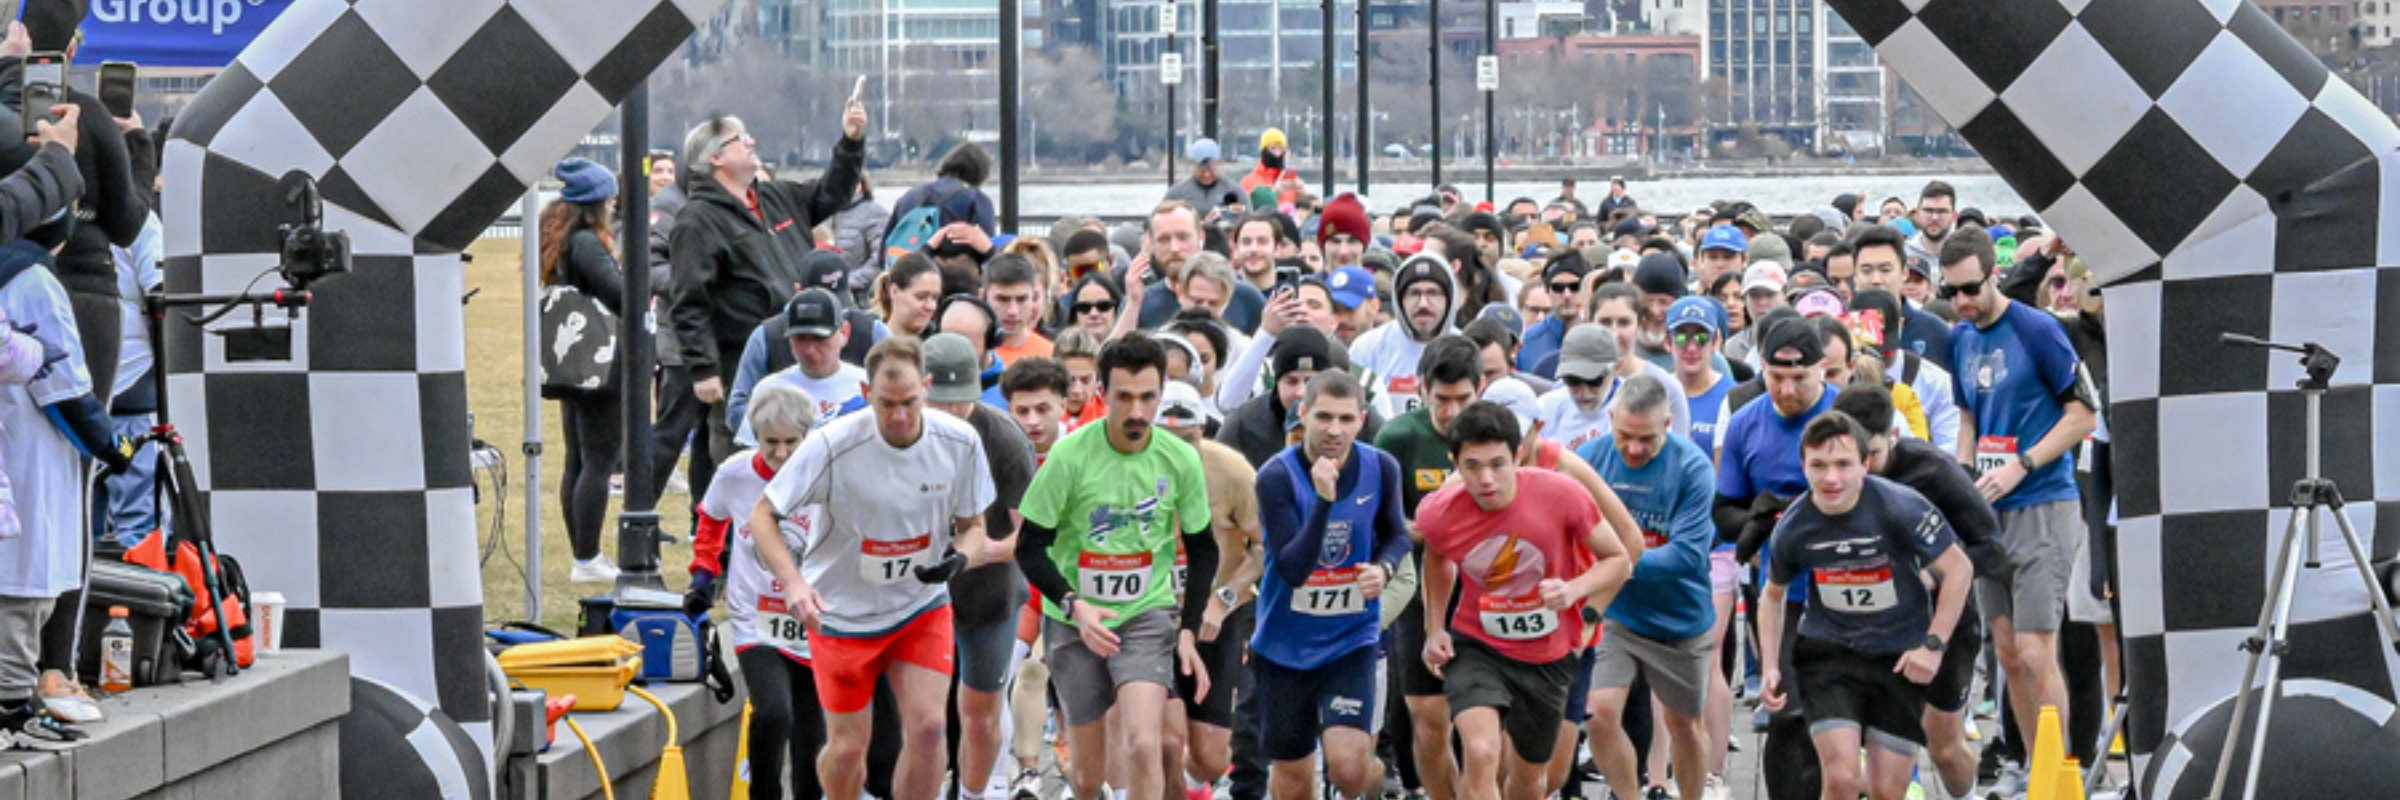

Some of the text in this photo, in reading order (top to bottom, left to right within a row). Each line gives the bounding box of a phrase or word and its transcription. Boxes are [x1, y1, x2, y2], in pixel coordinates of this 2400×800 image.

[1092, 573, 1141, 595] 170
[1308, 587, 1352, 609] 171
[1841, 589, 1875, 606] 12
[1496, 613, 1545, 634] 143
